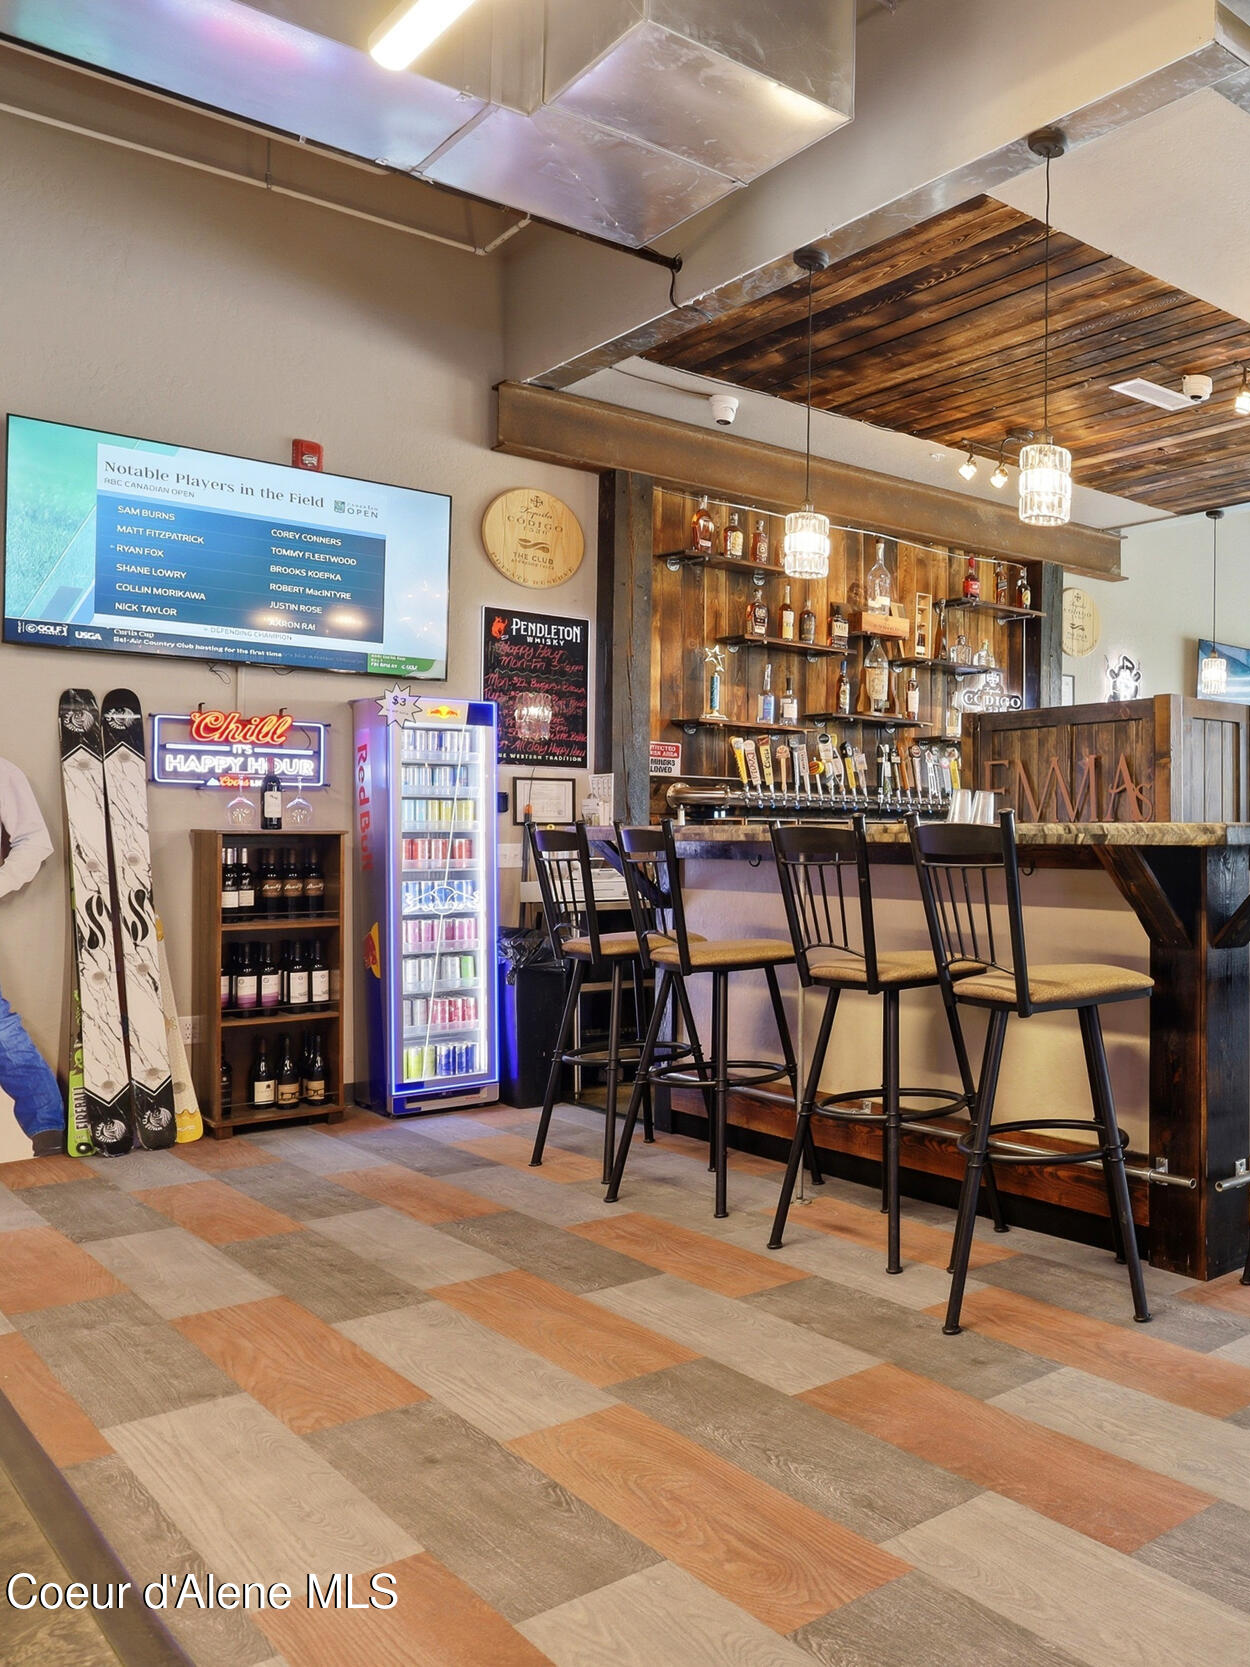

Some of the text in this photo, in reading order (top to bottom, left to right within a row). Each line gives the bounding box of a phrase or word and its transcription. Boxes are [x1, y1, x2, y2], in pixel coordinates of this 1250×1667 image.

[104, 461, 324, 508] Notable Players in the Field
[104, 478, 195, 498] RBC CANADIAN OPEN
[118, 506, 176, 520] SAM BURNS
[347, 508, 379, 518] OPEN
[116, 525, 205, 544] MATT FITZPATRICK
[271, 528, 342, 546] COREY CONNERS
[116, 544, 164, 558] RYAN FOX
[271, 547, 356, 566] TOMMY FLEETWOOD
[513, 552, 528, 561] THE
[532, 556, 554, 565] CLUB
[116, 564, 187, 579] SHANE LOWRY
[270, 565, 306, 577] BROOKS
[116, 582, 206, 600] COLLIN MORIKAWA
[270, 583, 352, 600] ROBERT MacINTYRE
[115, 602, 177, 616] NICK TAYLOR
[270, 601, 322, 614] JUSTIN ROSE
[75, 630, 102, 640] USGA
[139, 631, 154, 639] Cup
[511, 618, 581, 642] PENDLETON
[144, 639, 175, 648] Country
[176, 641, 194, 649] Club
[195, 644, 223, 653] hosting
[266, 650, 282, 658] time
[526, 636, 565, 646] WHISKY
[392, 695, 406, 706] $3
[191, 711, 293, 744] Chill
[232, 744, 252, 754] IT'S
[165, 754, 244, 773] HAPPY
[357, 744, 370, 806] Red
